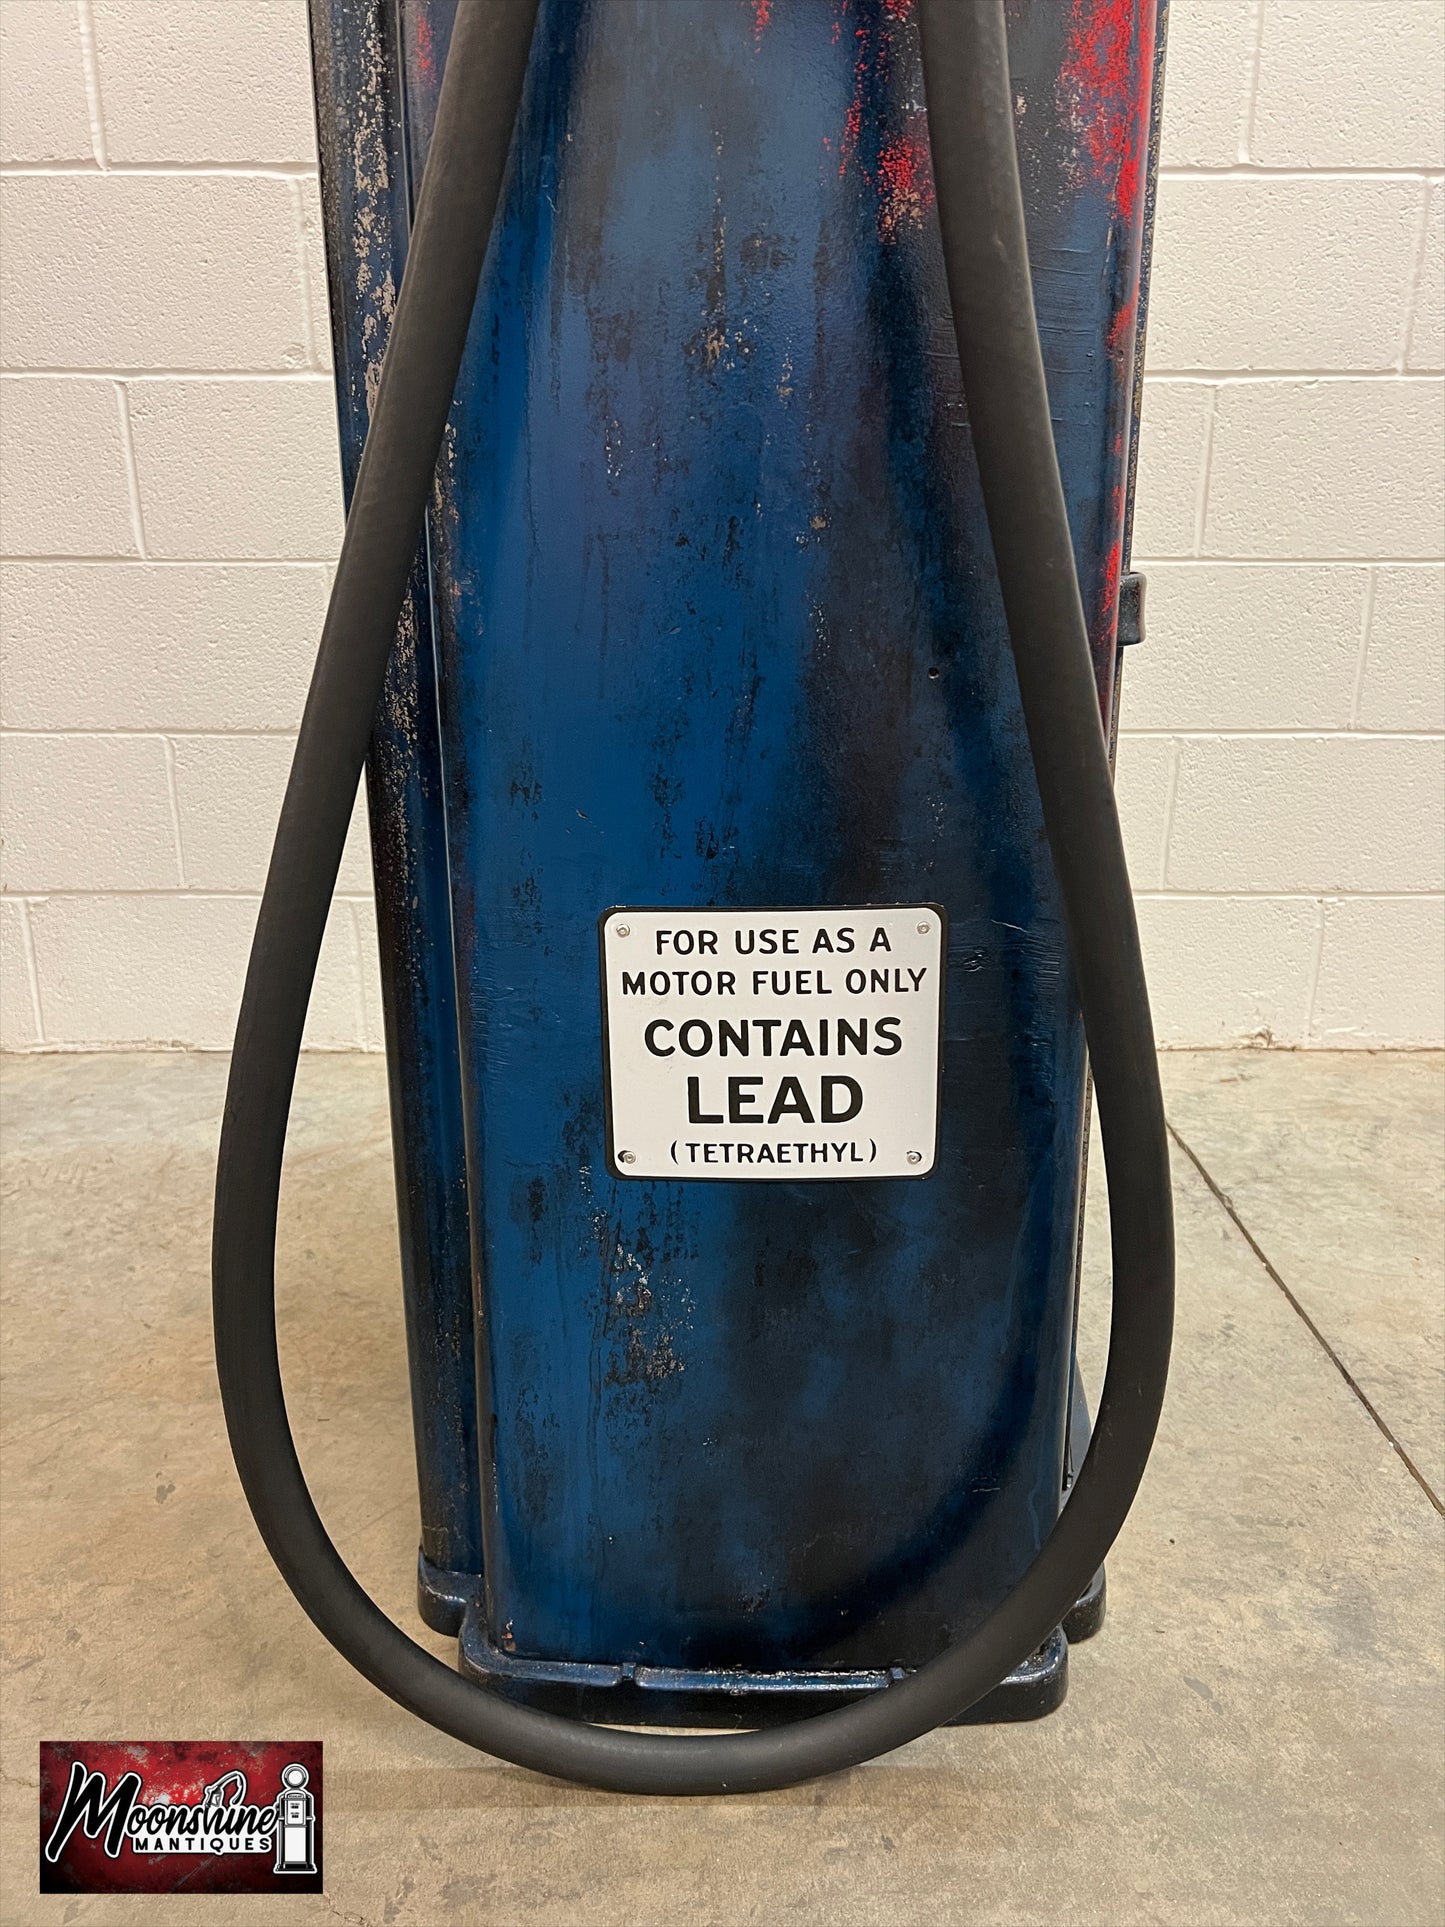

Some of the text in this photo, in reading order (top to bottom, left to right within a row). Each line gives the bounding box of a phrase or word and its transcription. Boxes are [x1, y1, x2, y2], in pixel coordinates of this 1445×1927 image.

[656, 927, 892, 955] FOR USE AS A
[622, 967, 927, 995] MOTOR FUEL ONLY
[644, 1016, 902, 1057] CONTAINS
[687, 1075, 864, 1124] LEAD
